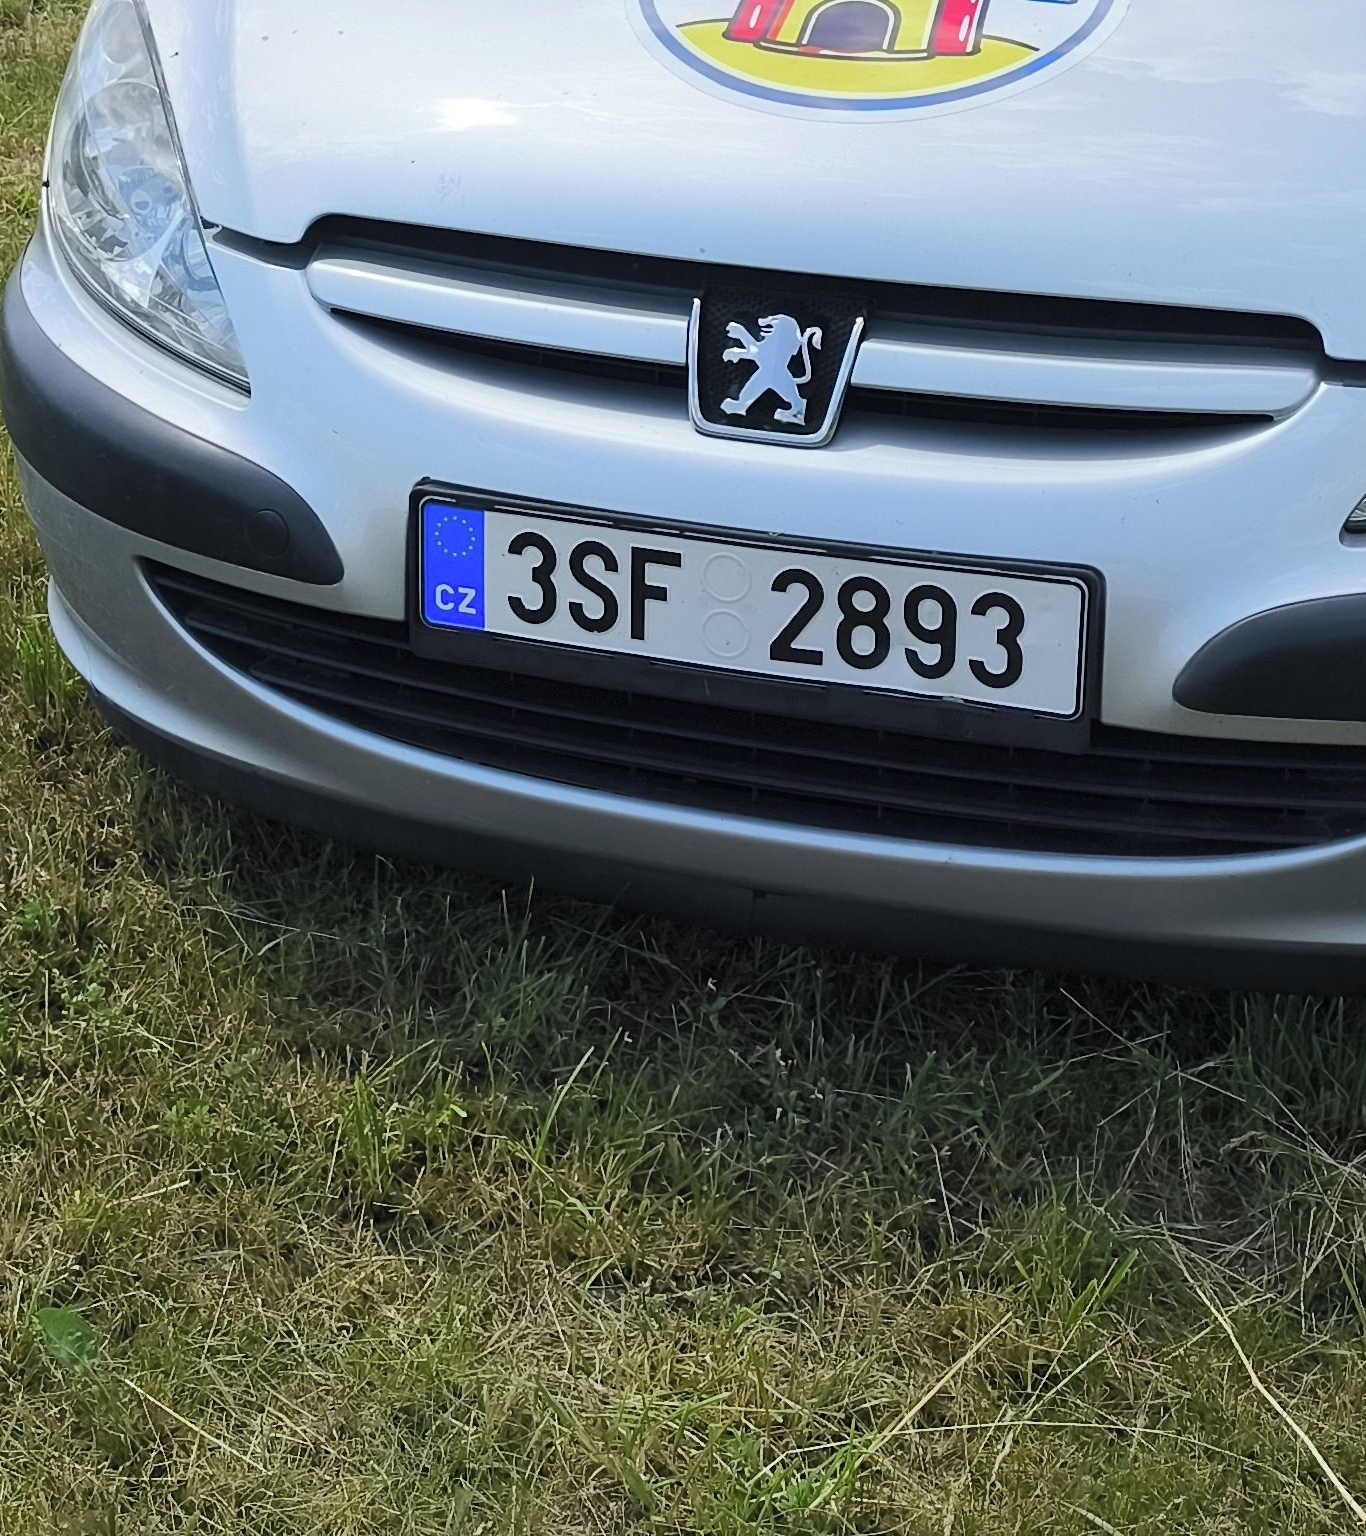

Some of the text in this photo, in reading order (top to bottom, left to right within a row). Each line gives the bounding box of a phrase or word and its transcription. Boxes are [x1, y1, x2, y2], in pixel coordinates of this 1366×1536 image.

[434, 582, 477, 616] CZ
[507, 530, 1025, 689] 3SF 2893
